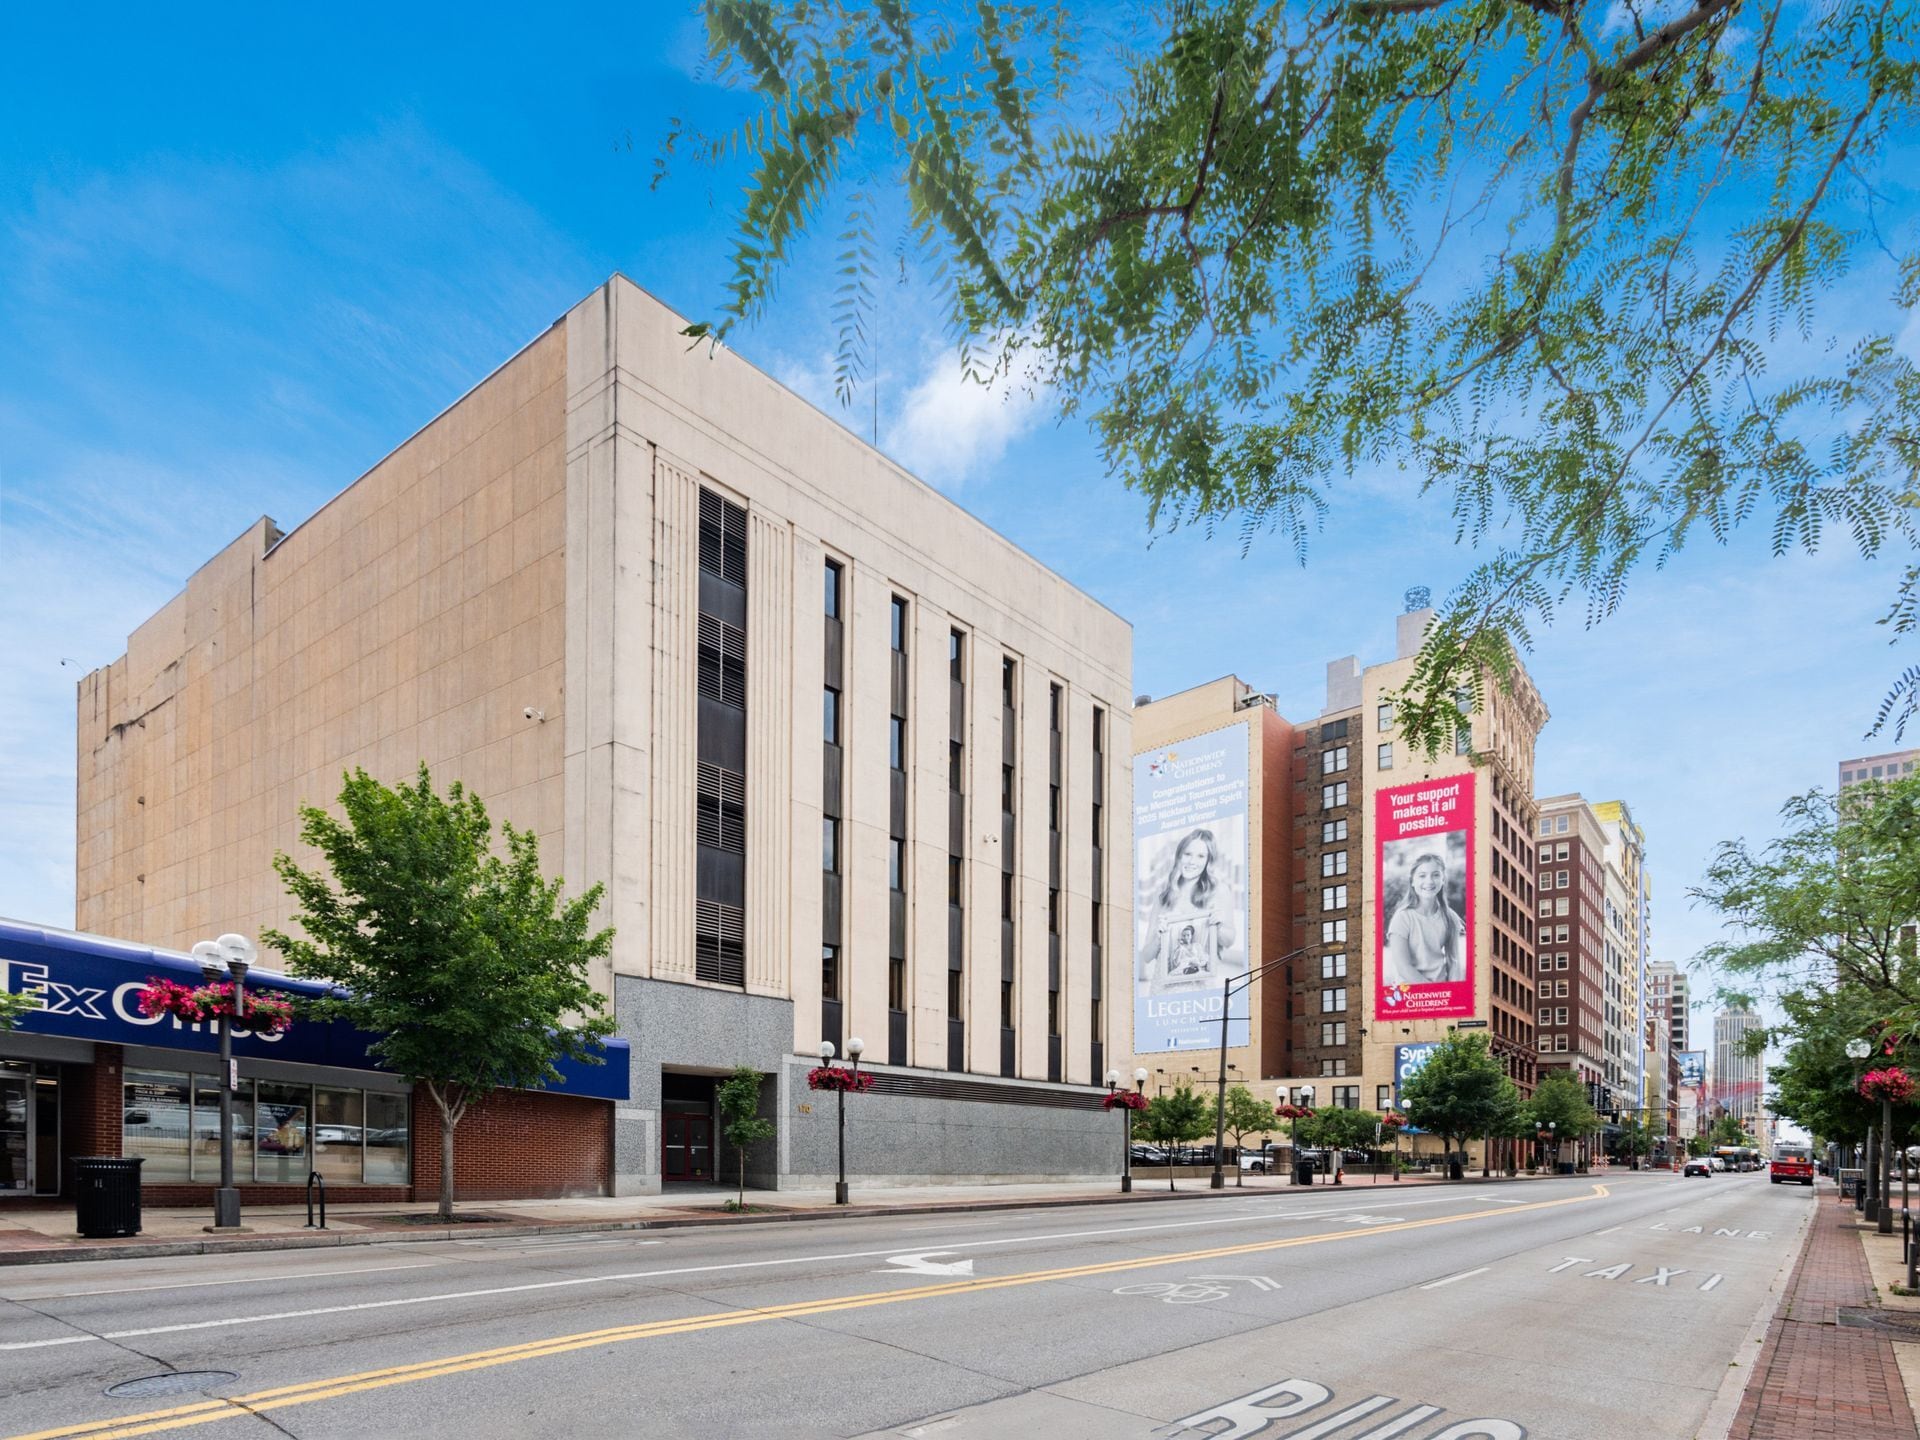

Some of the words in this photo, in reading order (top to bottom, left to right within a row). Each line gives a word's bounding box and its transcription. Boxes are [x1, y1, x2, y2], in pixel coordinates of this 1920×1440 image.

[1172, 748, 1226, 771] NATIONWIDE
[1151, 794, 1186, 810] Memorial
[1190, 780, 1244, 800] Tournament's
[1153, 775, 1214, 799] Congratulations
[1217, 774, 1225, 784] to
[1390, 794, 1415, 806] Your
[1417, 784, 1460, 802] support
[1195, 798, 1217, 810] Youth
[1220, 791, 1242, 806] Spirit
[1393, 804, 1428, 820] makes
[1432, 800, 1440, 813] it
[1442, 798, 1456, 811] all
[1161, 816, 1186, 829] Award
[1188, 810, 1216, 824] Winner
[1399, 815, 1449, 835] possible.
[1403, 991, 1452, 1000] NATIONWIDE
[1406, 998, 1449, 1008] CHILDREN'S
[798, 1104, 812, 1114] 170
[1648, 1223, 1776, 1240] LANE
[1547, 1256, 1725, 1291] TAXI
